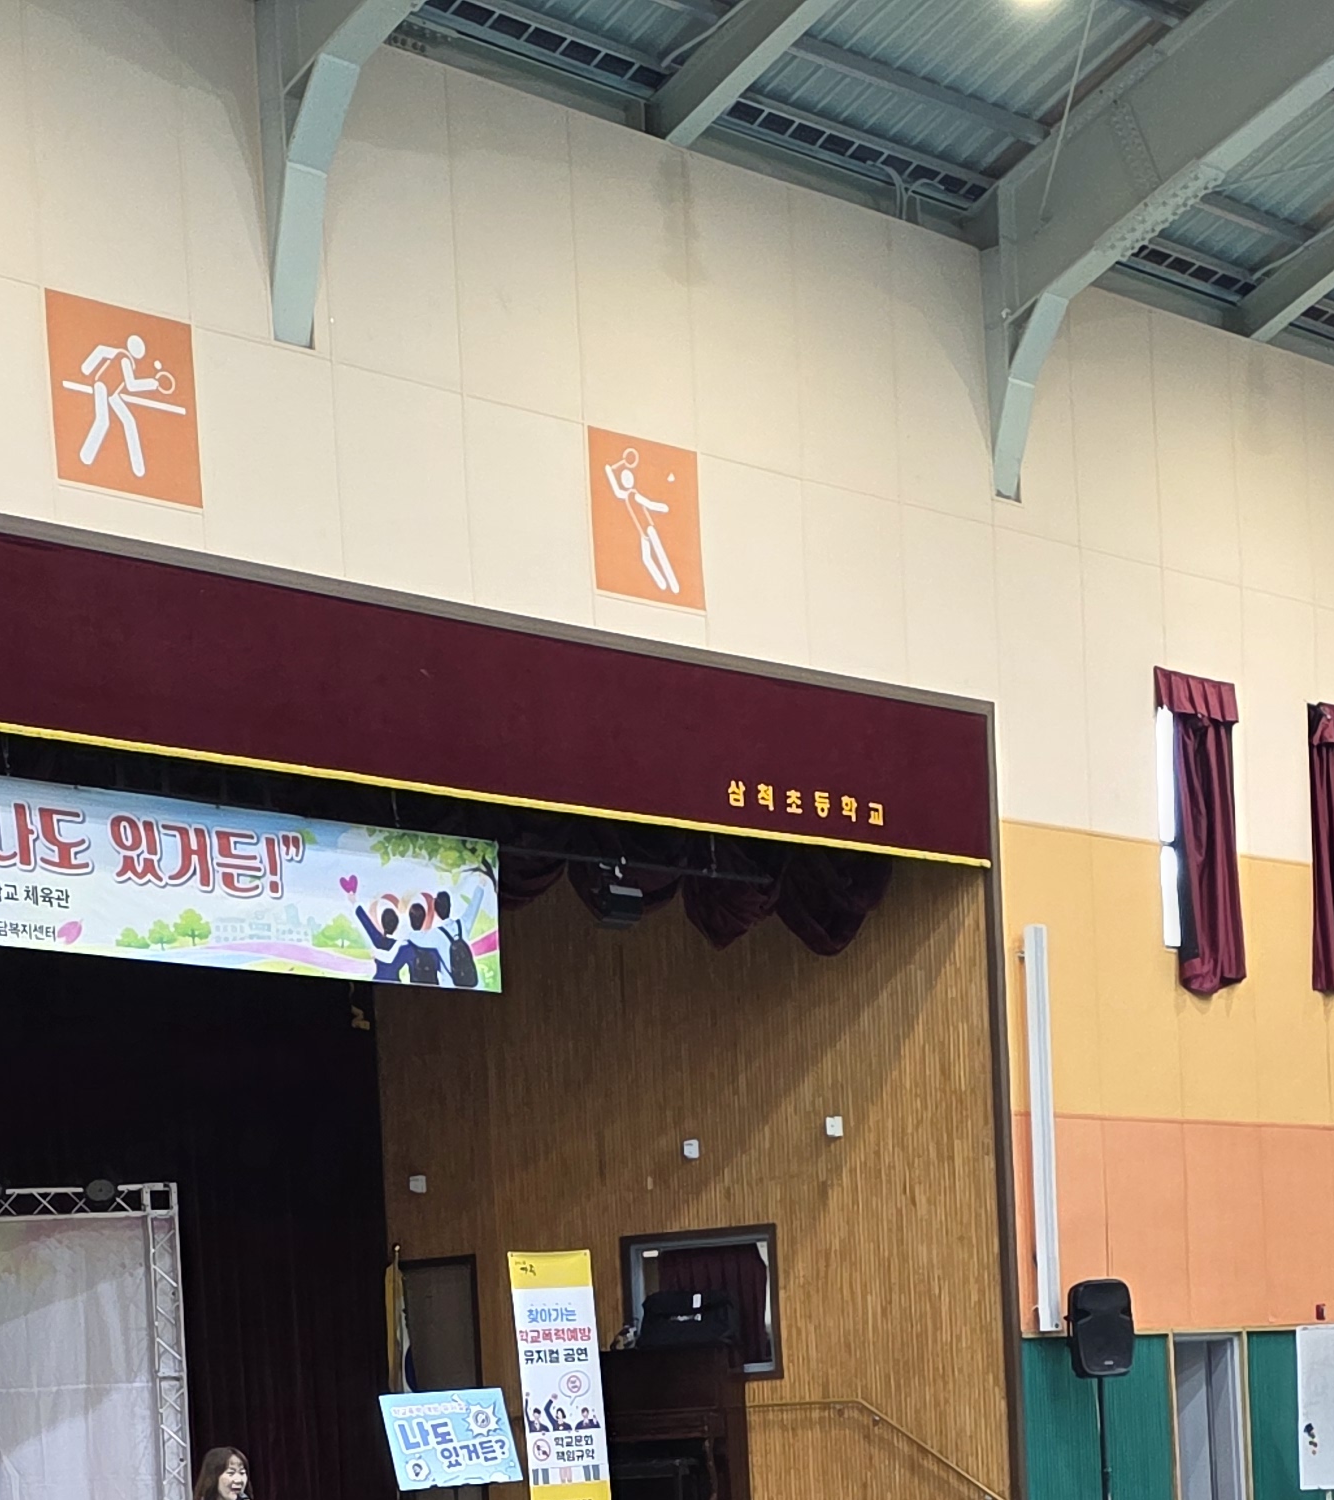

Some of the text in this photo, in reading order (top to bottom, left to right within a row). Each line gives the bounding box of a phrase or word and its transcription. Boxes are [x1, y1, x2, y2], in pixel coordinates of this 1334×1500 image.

[24, 885, 71, 909] 체육관
[527, 1307, 577, 1323] 찾아가는
[519, 1326, 592, 1344] 학교폭력예방
[524, 1347, 589, 1364] 뮤지컬 공연
[397, 1421, 454, 1451] 나도
[440, 1439, 506, 1469] 있거든?
